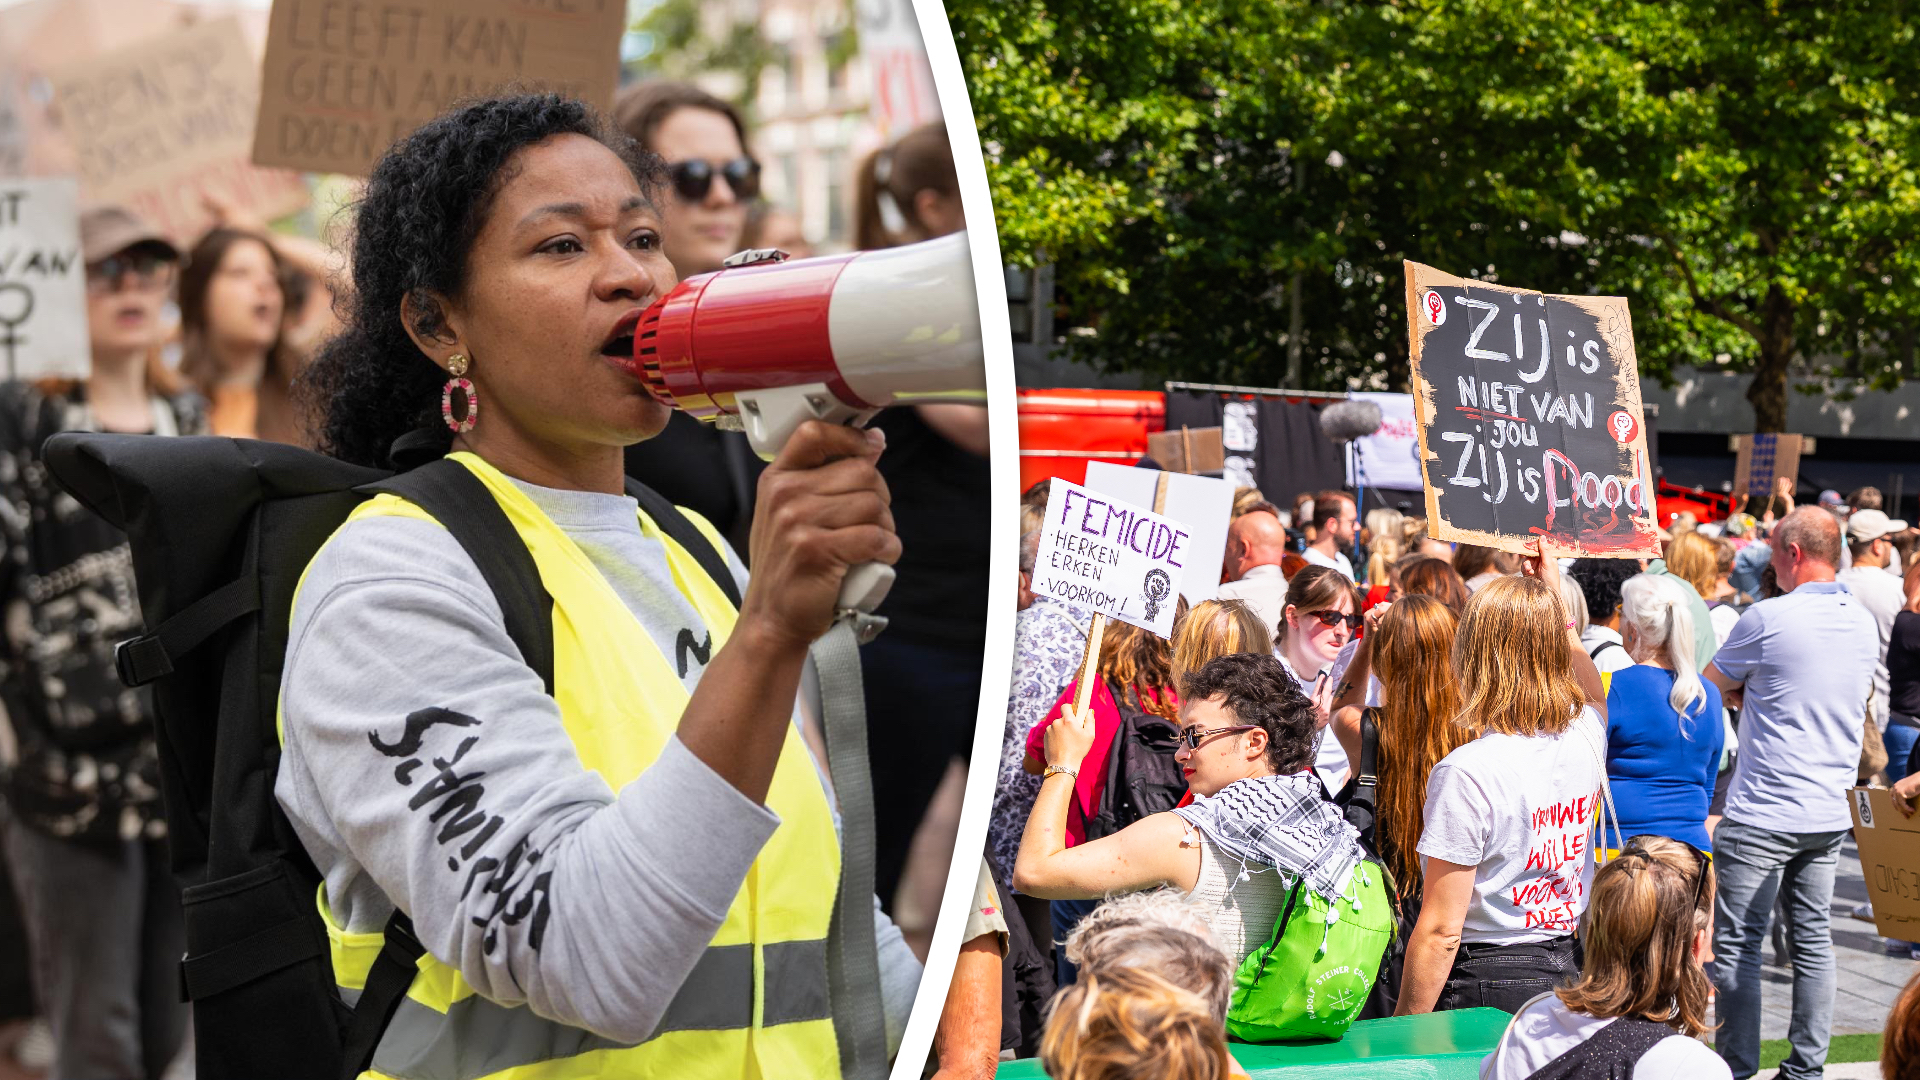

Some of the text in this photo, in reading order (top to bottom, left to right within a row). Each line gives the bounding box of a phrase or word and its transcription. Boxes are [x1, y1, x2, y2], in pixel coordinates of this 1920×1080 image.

[288, 0, 527, 71] LEEFT KAN
[285, 56, 397, 110] GEEN
[280, 114, 378, 159] DOEN
[1566, 330, 1600, 374] is
[1457, 376, 1595, 430] NIET VAN
[1516, 458, 1542, 504] is
[1055, 529, 1120, 567] HERKEN
[1061, 488, 1189, 569] FEMICIDE
[1306, 987, 1317, 1020] RUDOLF
[1315, 965, 1350, 986] STEINER
